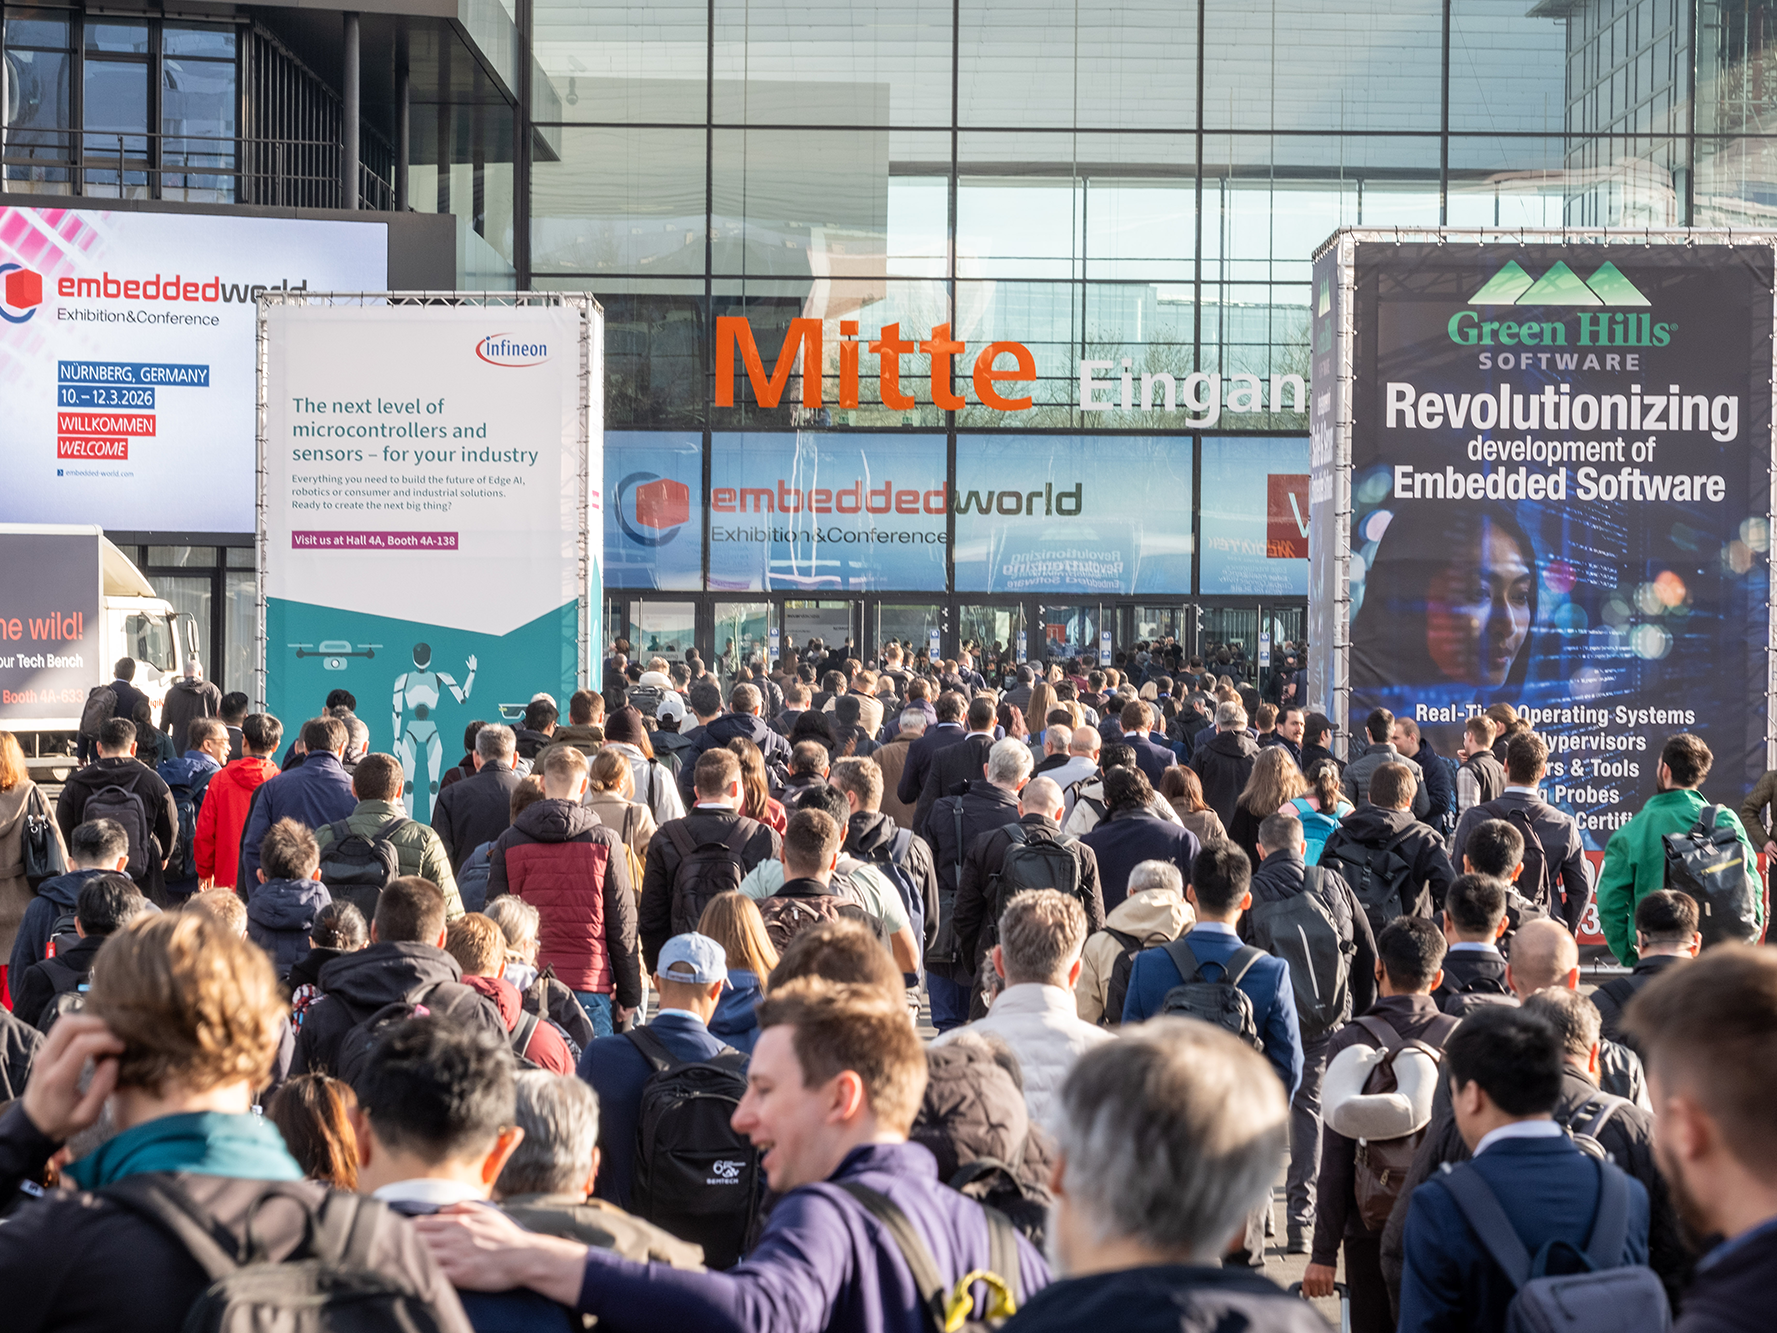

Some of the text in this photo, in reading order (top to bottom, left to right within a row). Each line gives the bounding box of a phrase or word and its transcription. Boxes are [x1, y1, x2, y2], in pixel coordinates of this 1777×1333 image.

[58, 308, 219, 326] Exhibition&Conference
[1448, 311, 1567, 346] Green
[486, 336, 547, 356] infineon
[1479, 353, 1640, 371] SOFTWARE
[60, 362, 208, 384] NÜRNBERG, GERMANY
[715, 316, 1306, 428] Mitte Eingan
[92, 390, 153, 406] 12.3.2026
[293, 397, 444, 414] The next level of
[1385, 381, 1738, 442] Revolutionizing
[60, 416, 153, 433] WILLKOMMEN
[294, 421, 486, 438] microcontrollers and
[60, 442, 126, 457] WELCOME
[293, 449, 362, 461] sensors
[383, 446, 409, 461] for
[414, 450, 456, 466] your
[462, 446, 538, 466] industry
[1467, 434, 1656, 466] development of
[292, 474, 343, 486] Everything
[345, 477, 362, 485] you
[365, 475, 387, 483] need
[402, 475, 425, 484] build
[428, 476, 443, 484] the
[446, 475, 477, 485] future
[477, 475, 487, 485] of
[488, 476, 511, 487] Edge
[513, 476, 525, 486] AI,
[1393, 465, 1726, 502] Embedded Software
[292, 488, 330, 496] robotics
[413, 489, 458, 497] industrial
[461, 489, 505, 497] solutions.
[711, 479, 1082, 516] embeddedworld
[292, 501, 320, 510] Ready
[366, 501, 381, 509] the
[407, 501, 421, 512] big
[423, 502, 452, 512] thing?
[294, 535, 455, 547] Visit us at Hall 4A, Booth 4A-138
[711, 526, 947, 544] Exhibition&Conference
[28, 611, 83, 641] wild!
[16, 654, 45, 668] Tech
[46, 654, 84, 668] Bench
[3, 688, 84, 704] Booth 4A-633
[1416, 704, 1696, 728] Real-Ti Operating Systems
[1570, 758, 1584, 777] &
[1591, 759, 1640, 778] Tools
[1555, 784, 1620, 804] Probes
